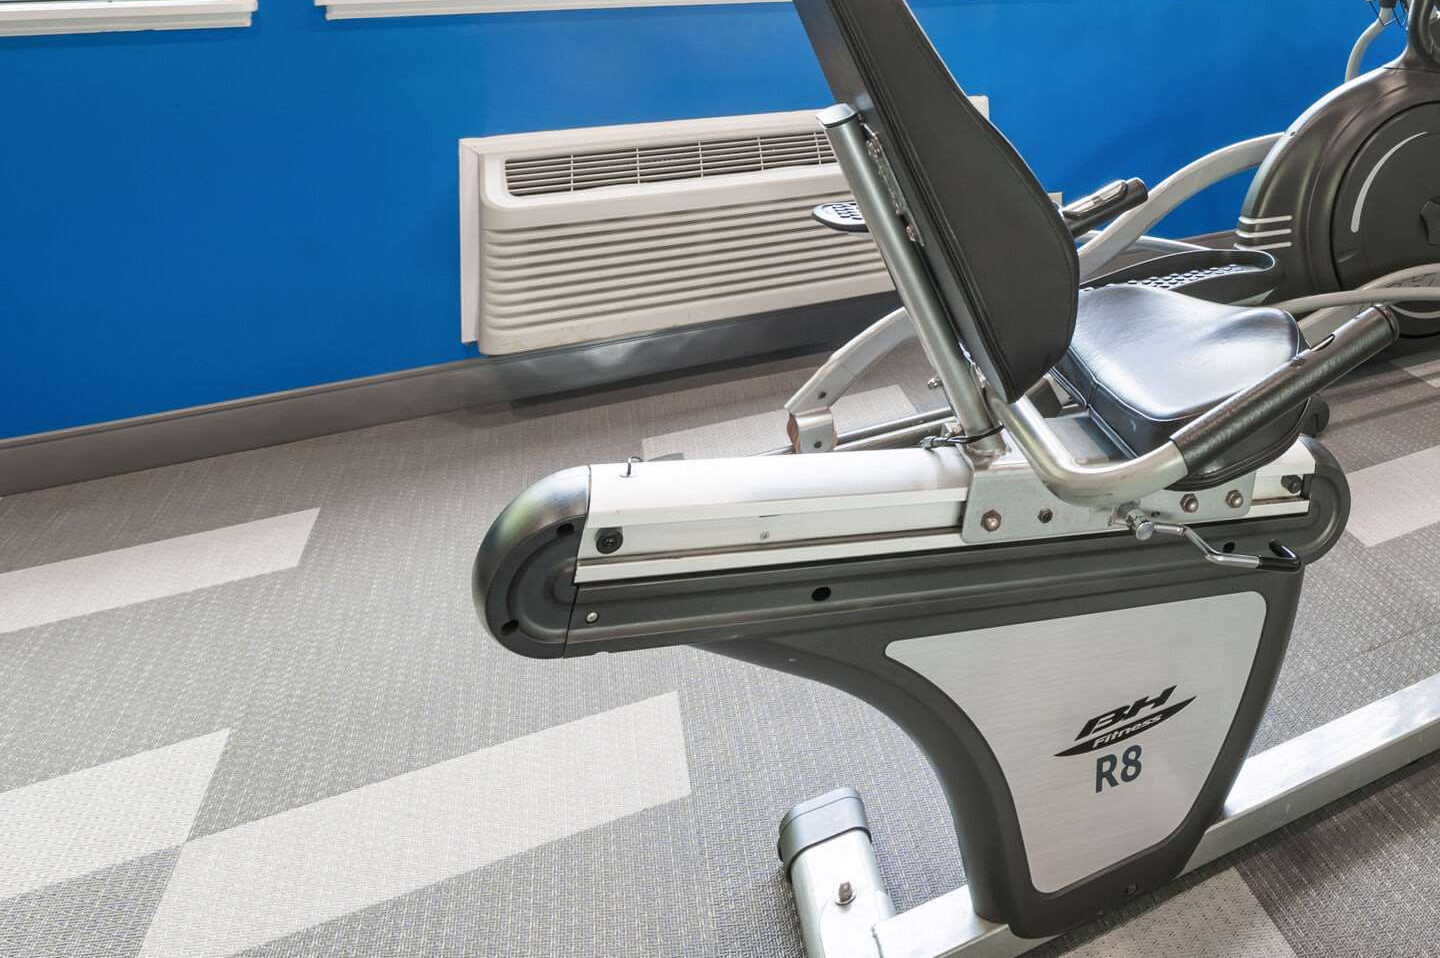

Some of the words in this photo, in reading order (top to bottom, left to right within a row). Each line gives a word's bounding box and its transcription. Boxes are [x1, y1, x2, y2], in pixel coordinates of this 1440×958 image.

[1074, 684, 1177, 742] BH
[1092, 713, 1163, 749] Fitness
[1095, 744, 1143, 794] R8
